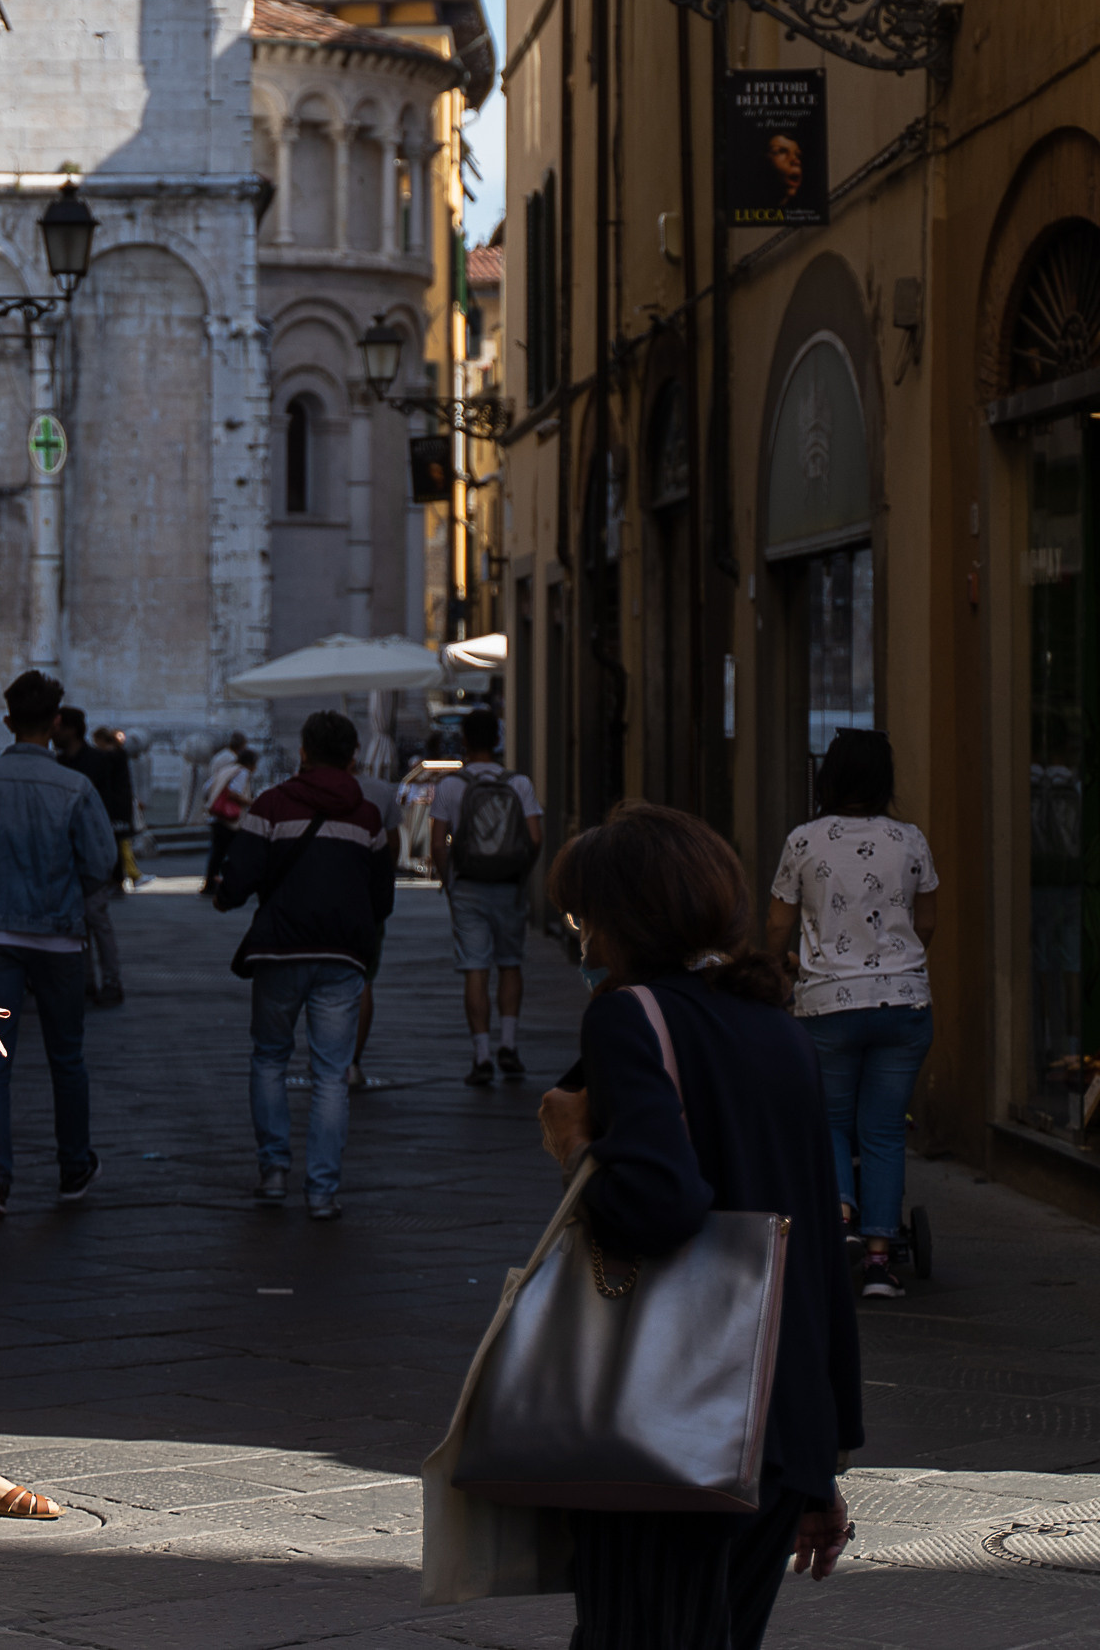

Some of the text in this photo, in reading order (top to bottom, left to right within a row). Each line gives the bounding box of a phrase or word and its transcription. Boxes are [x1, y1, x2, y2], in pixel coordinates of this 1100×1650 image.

[735, 93, 819, 106] DELLA LUCE
[734, 208, 785, 222] LUCCA
